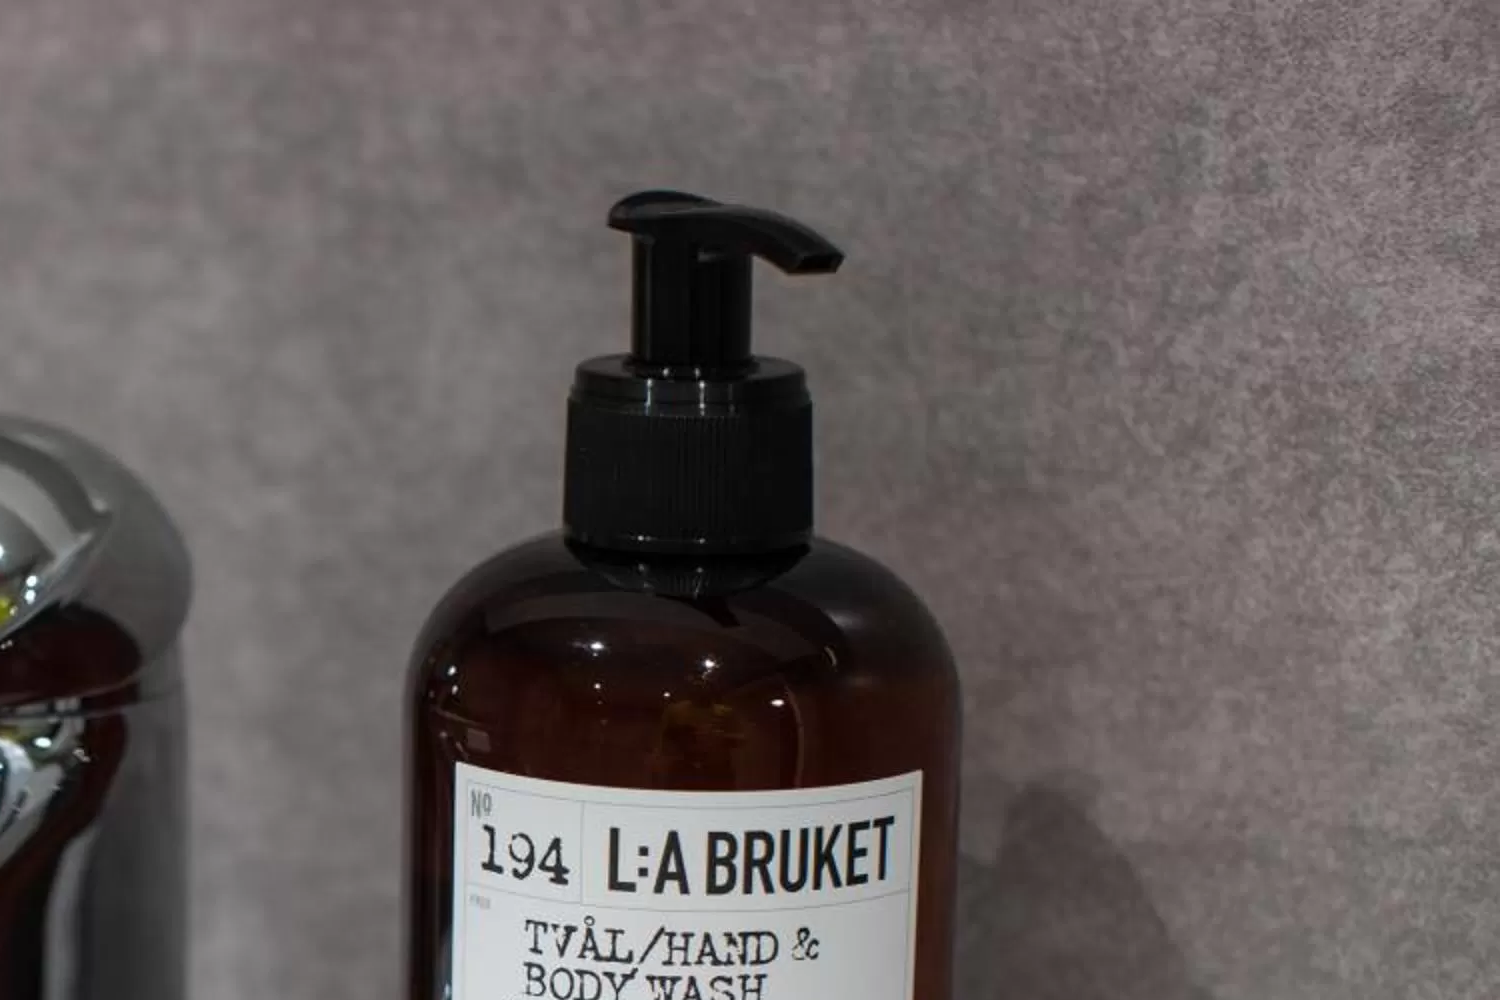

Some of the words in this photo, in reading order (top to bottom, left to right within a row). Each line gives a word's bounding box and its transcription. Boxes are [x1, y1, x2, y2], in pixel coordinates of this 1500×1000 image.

[481, 824, 570, 886] 194
[608, 826, 690, 895] L:A
[706, 815, 895, 895] BRUKET
[524, 915, 779, 966] TVÅL/HAND
[791, 927, 820, 961] &
